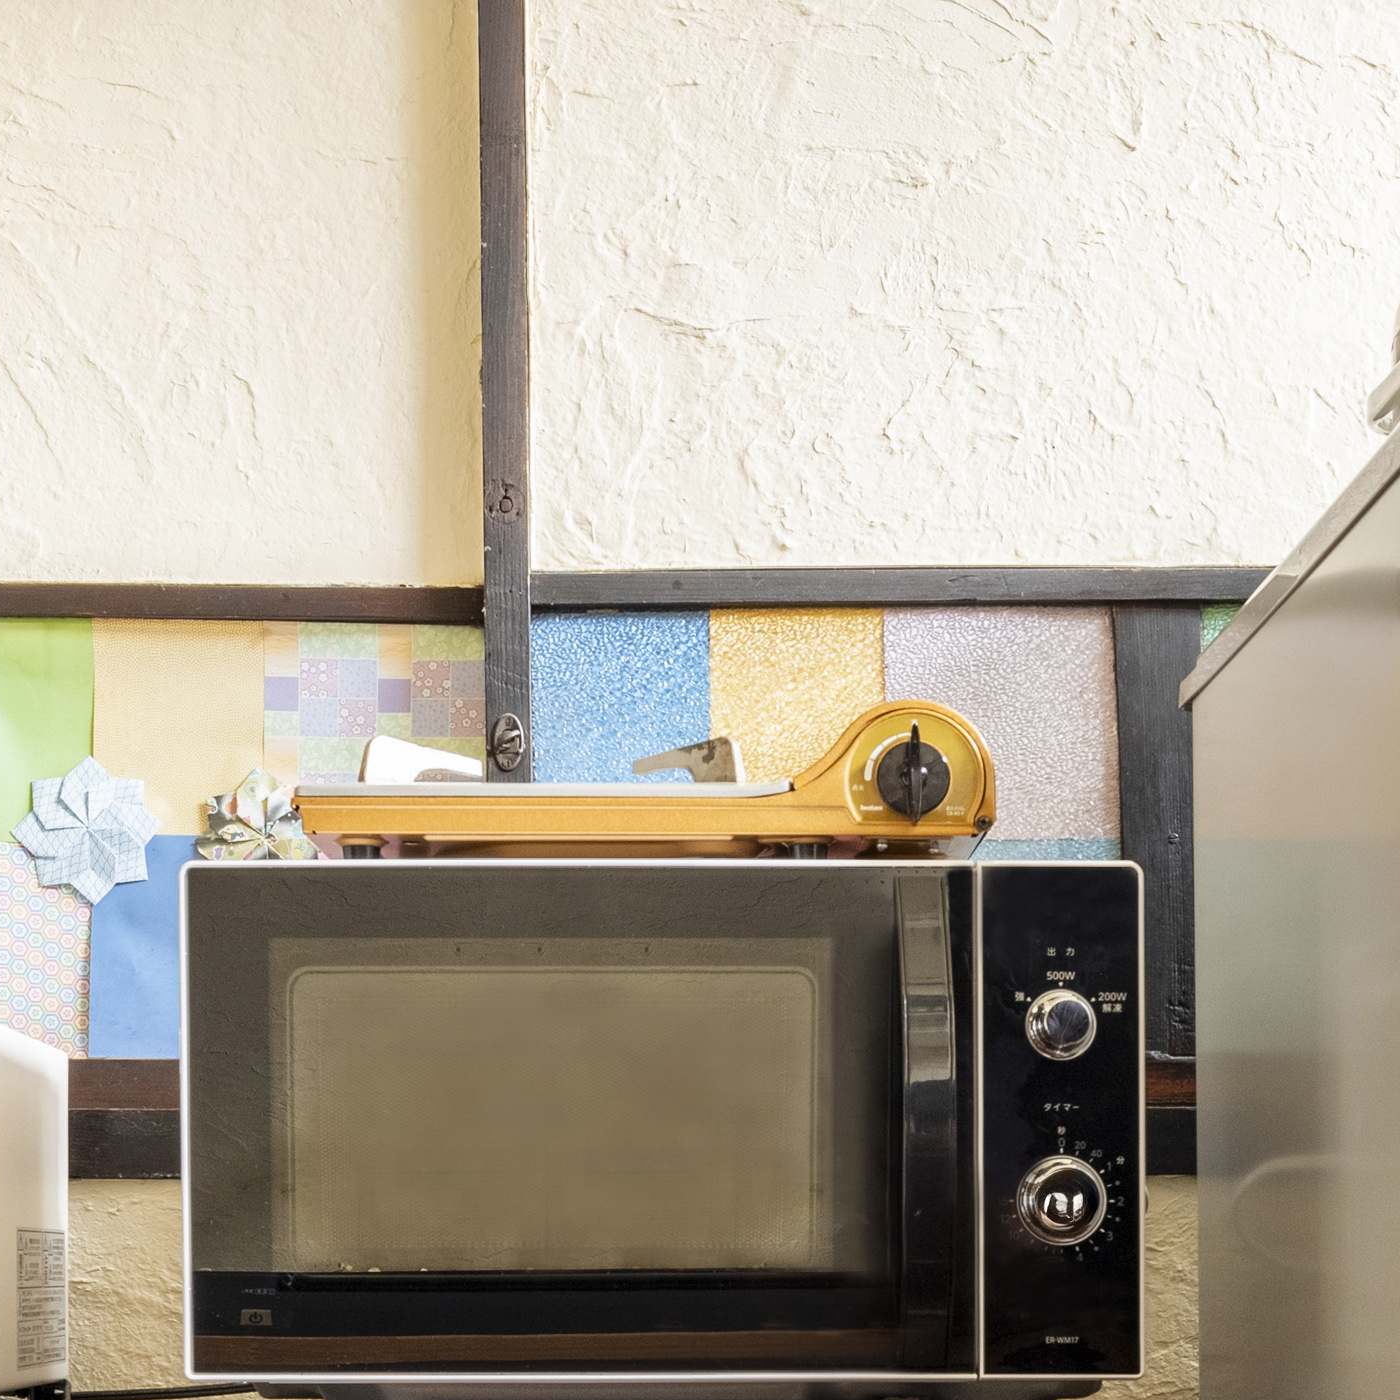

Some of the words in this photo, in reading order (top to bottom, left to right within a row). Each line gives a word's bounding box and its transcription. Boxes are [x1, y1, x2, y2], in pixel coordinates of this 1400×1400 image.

[1046, 971, 1076, 981] 500W
[1098, 992, 1128, 1002] 200W
[1044, 1102, 1080, 1112] タイマー
[1058, 1138, 1066, 1148] 0
[1074, 1141, 1087, 1150] 20
[1090, 1149, 1103, 1158] 40
[1117, 1196, 1124, 1206] 2
[1106, 1231, 1114, 1241] 3
[1076, 1252, 1083, 1262] 4
[1045, 1336, 1080, 1344] ER-WM17
